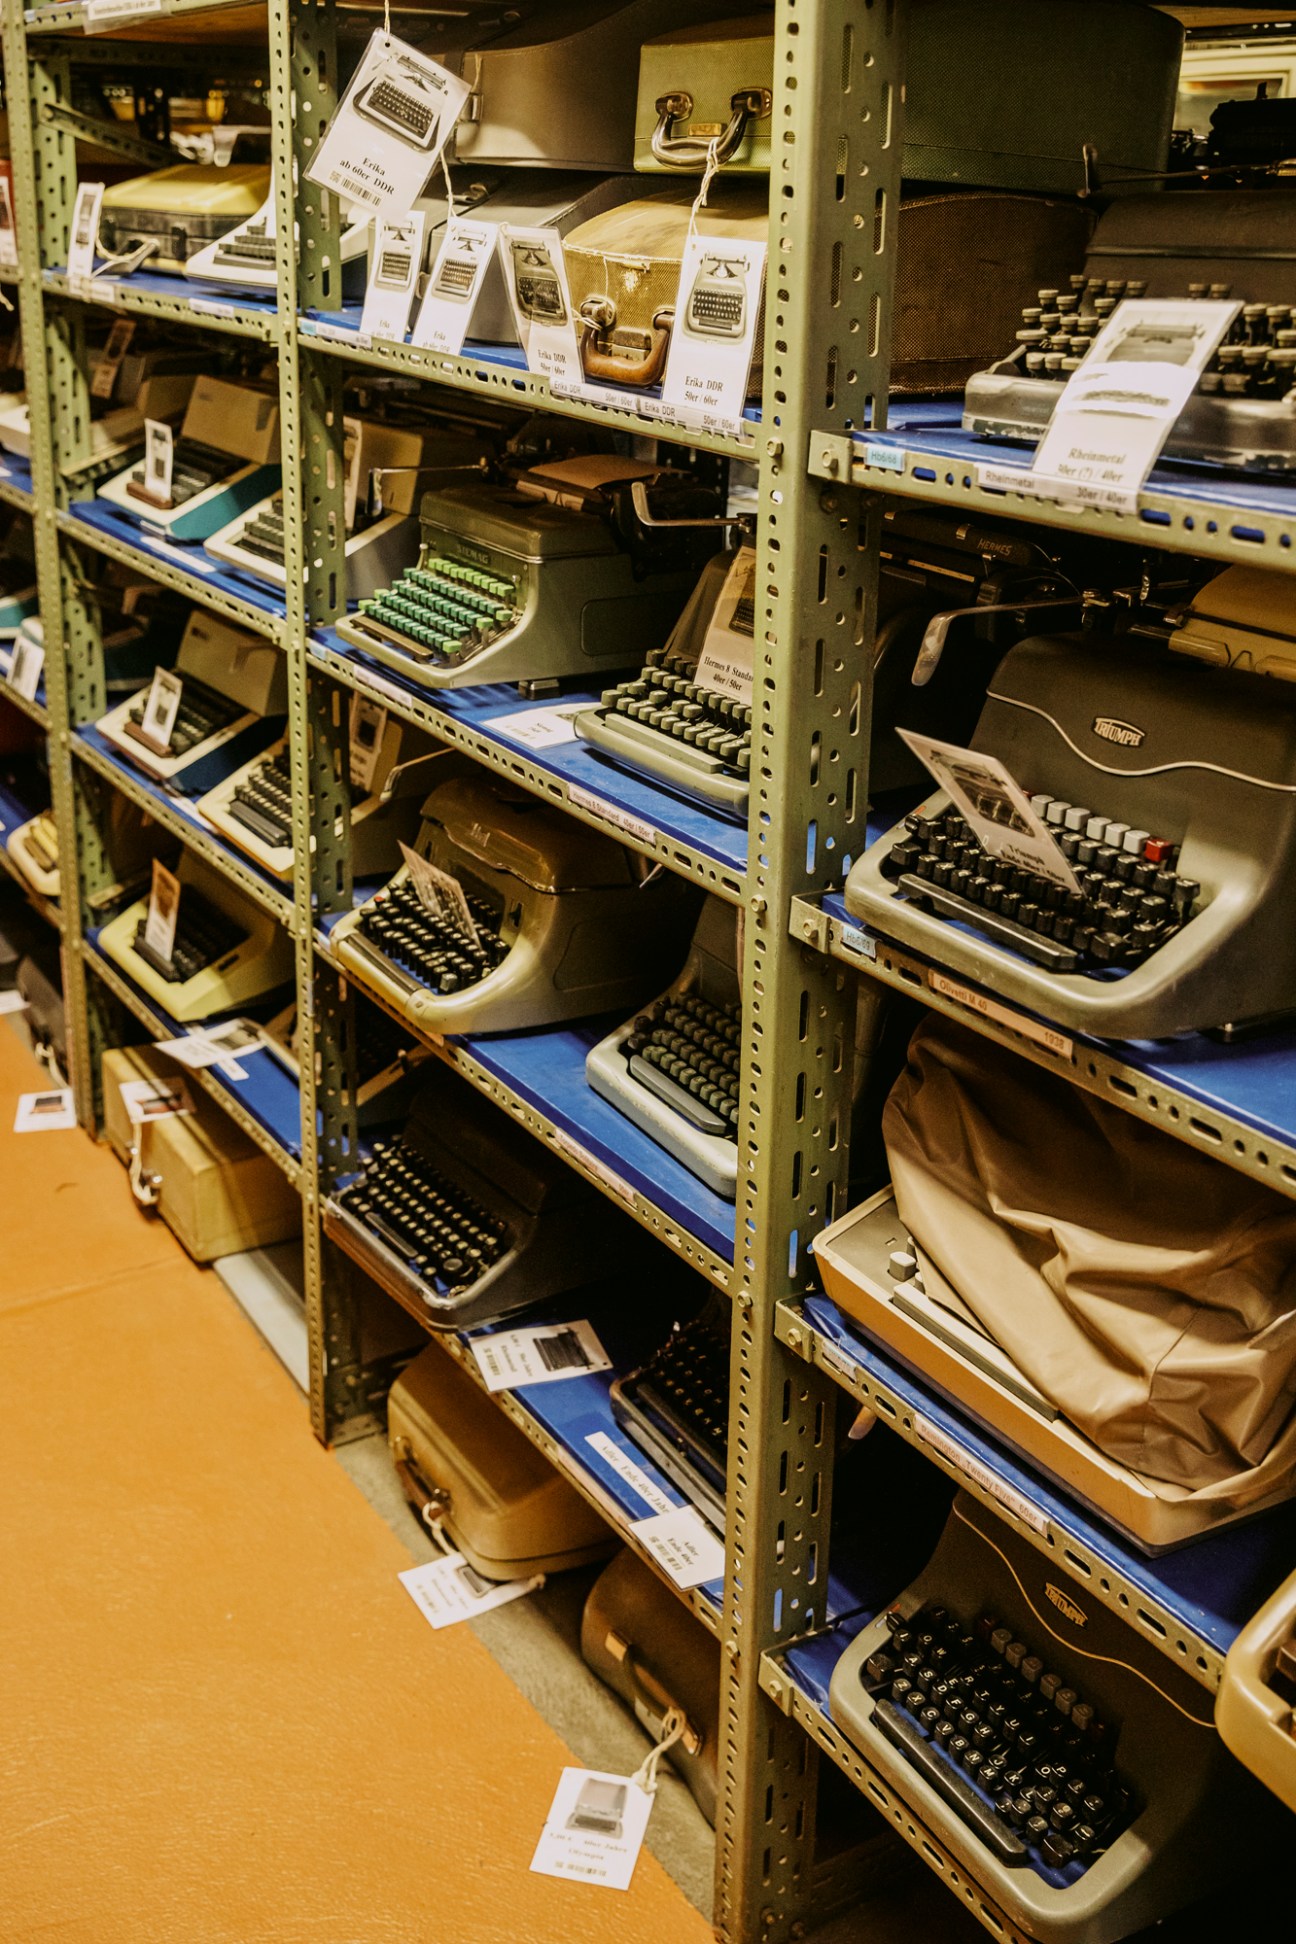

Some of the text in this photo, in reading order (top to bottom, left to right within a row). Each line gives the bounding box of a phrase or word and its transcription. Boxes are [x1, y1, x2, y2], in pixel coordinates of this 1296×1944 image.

[362, 157, 386, 176] Erika
[340, 160, 395, 195] ab 60er DDR
[537, 349, 567, 364] Erika DDR
[554, 382, 582, 395] Erika DDR
[685, 376, 724, 392] Erika DDR
[684, 391, 699, 403] 50er
[703, 396, 718, 406] 60er
[644, 402, 676, 417] Erika DDR
[703, 414, 717, 426] 50er
[721, 419, 735, 430] 60er
[985, 470, 1035, 488] Rheinmetal
[976, 538, 1013, 556] HERMES
[704, 656, 725, 671] Hermes
[729, 679, 742, 691] 50er
[1094, 718, 1145, 746] TRIUMPH
[939, 979, 988, 1012] Olivetti M 40
[1044, 1031, 1065, 1050] 1938
[620, 1465, 638, 1485] Ende
[921, 1425, 961, 1461] Remington
[1019, 1504, 1038, 1522] 60er
